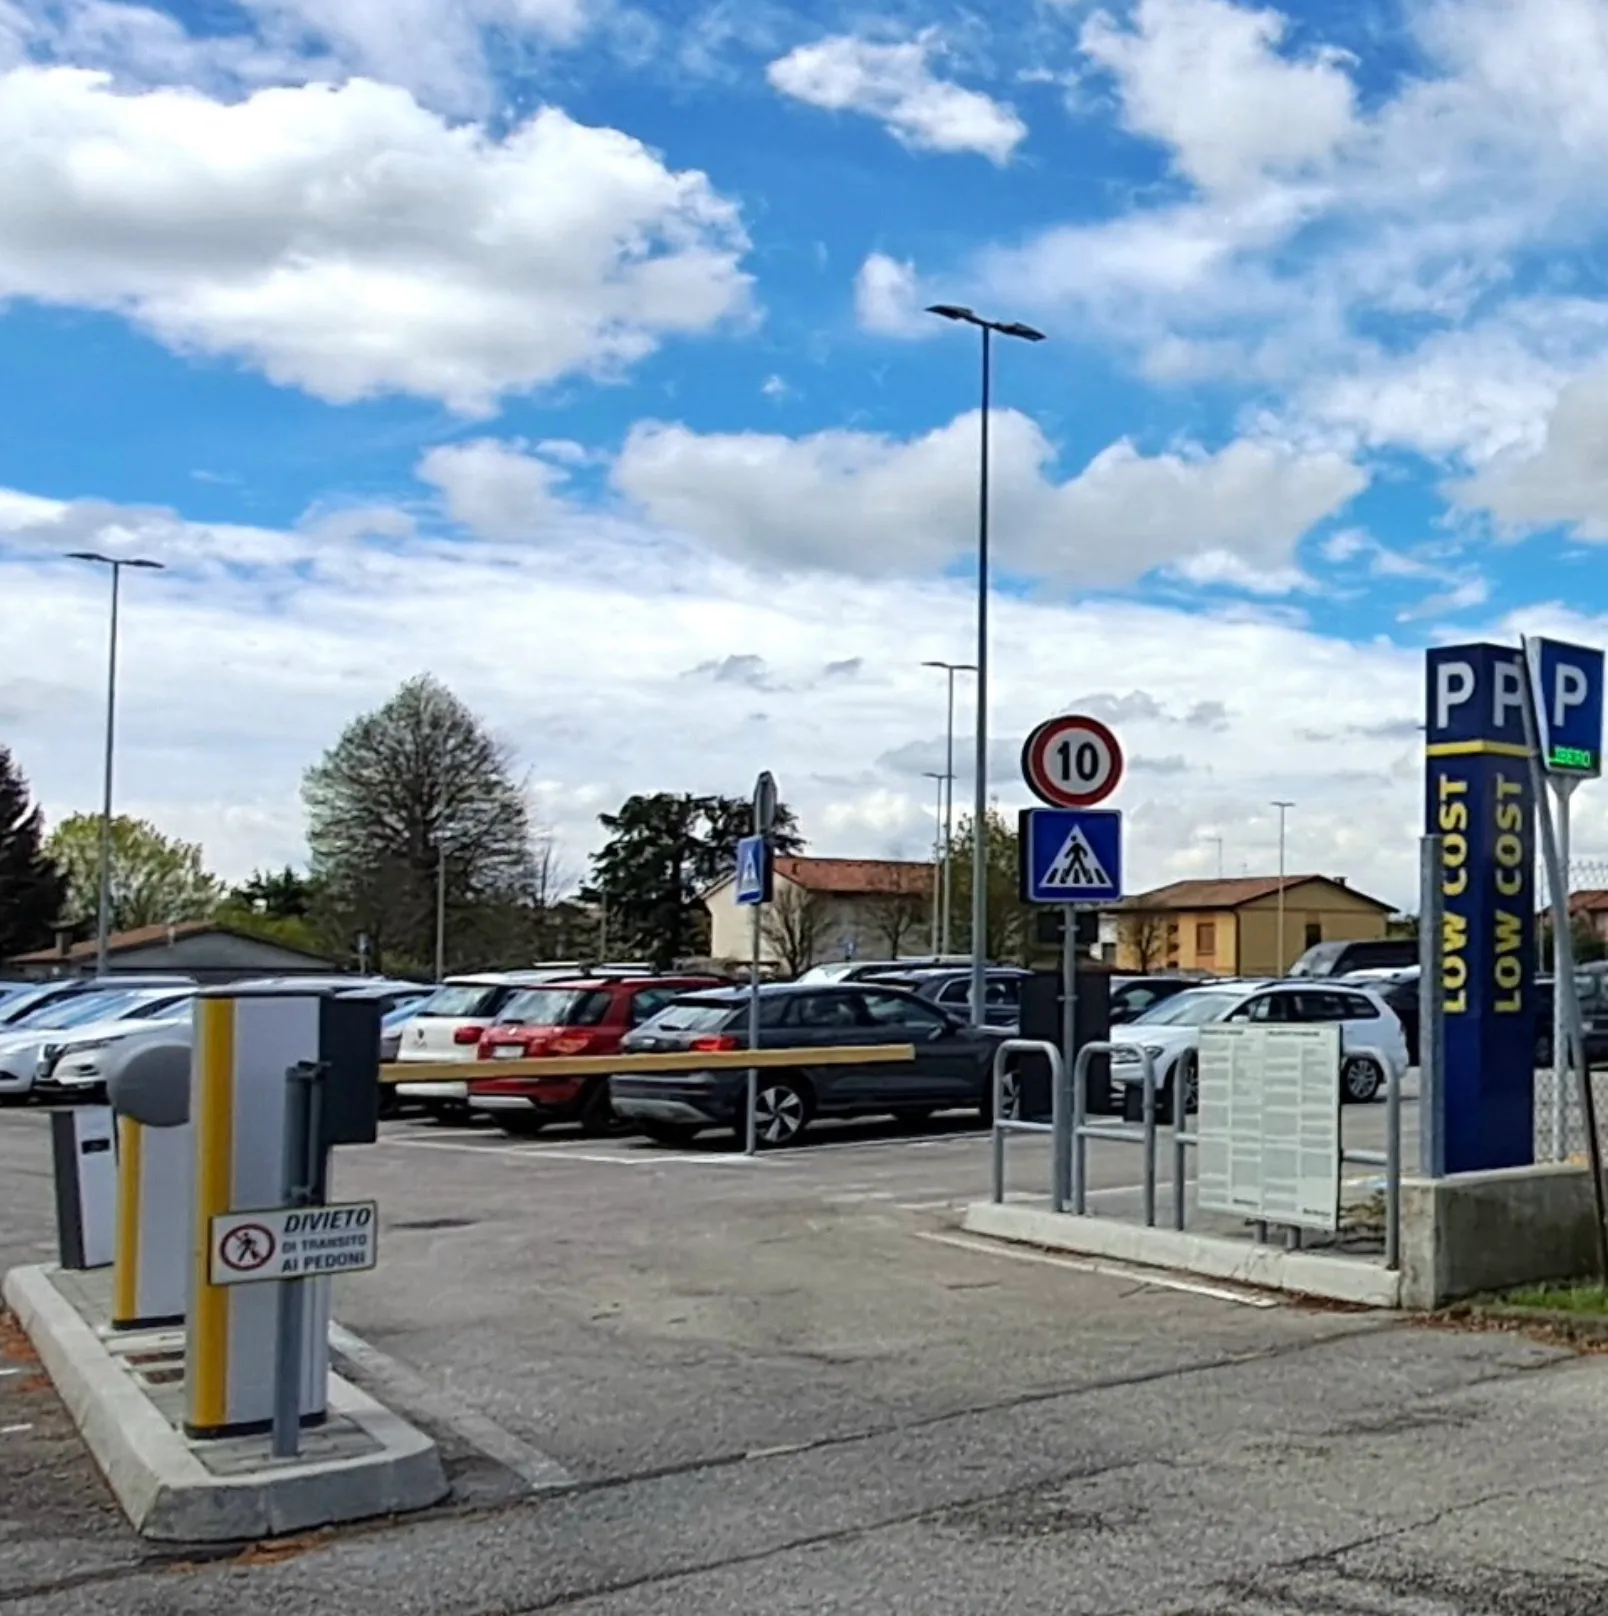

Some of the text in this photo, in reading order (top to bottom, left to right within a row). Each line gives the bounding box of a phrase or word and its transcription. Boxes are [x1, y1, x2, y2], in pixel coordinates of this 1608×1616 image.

[1437, 661, 1475, 729] P
[1493, 661, 1524, 727] P
[1553, 662, 1588, 727] P
[1057, 740, 1099, 782] 10
[1439, 773, 1468, 1013] LOW COST
[1494, 772, 1522, 1013] LOW COST
[282, 1234, 367, 1254] DI TRANSITO
[284, 1208, 371, 1233] DIVIETO
[282, 1251, 365, 1273] AI PEDONI
